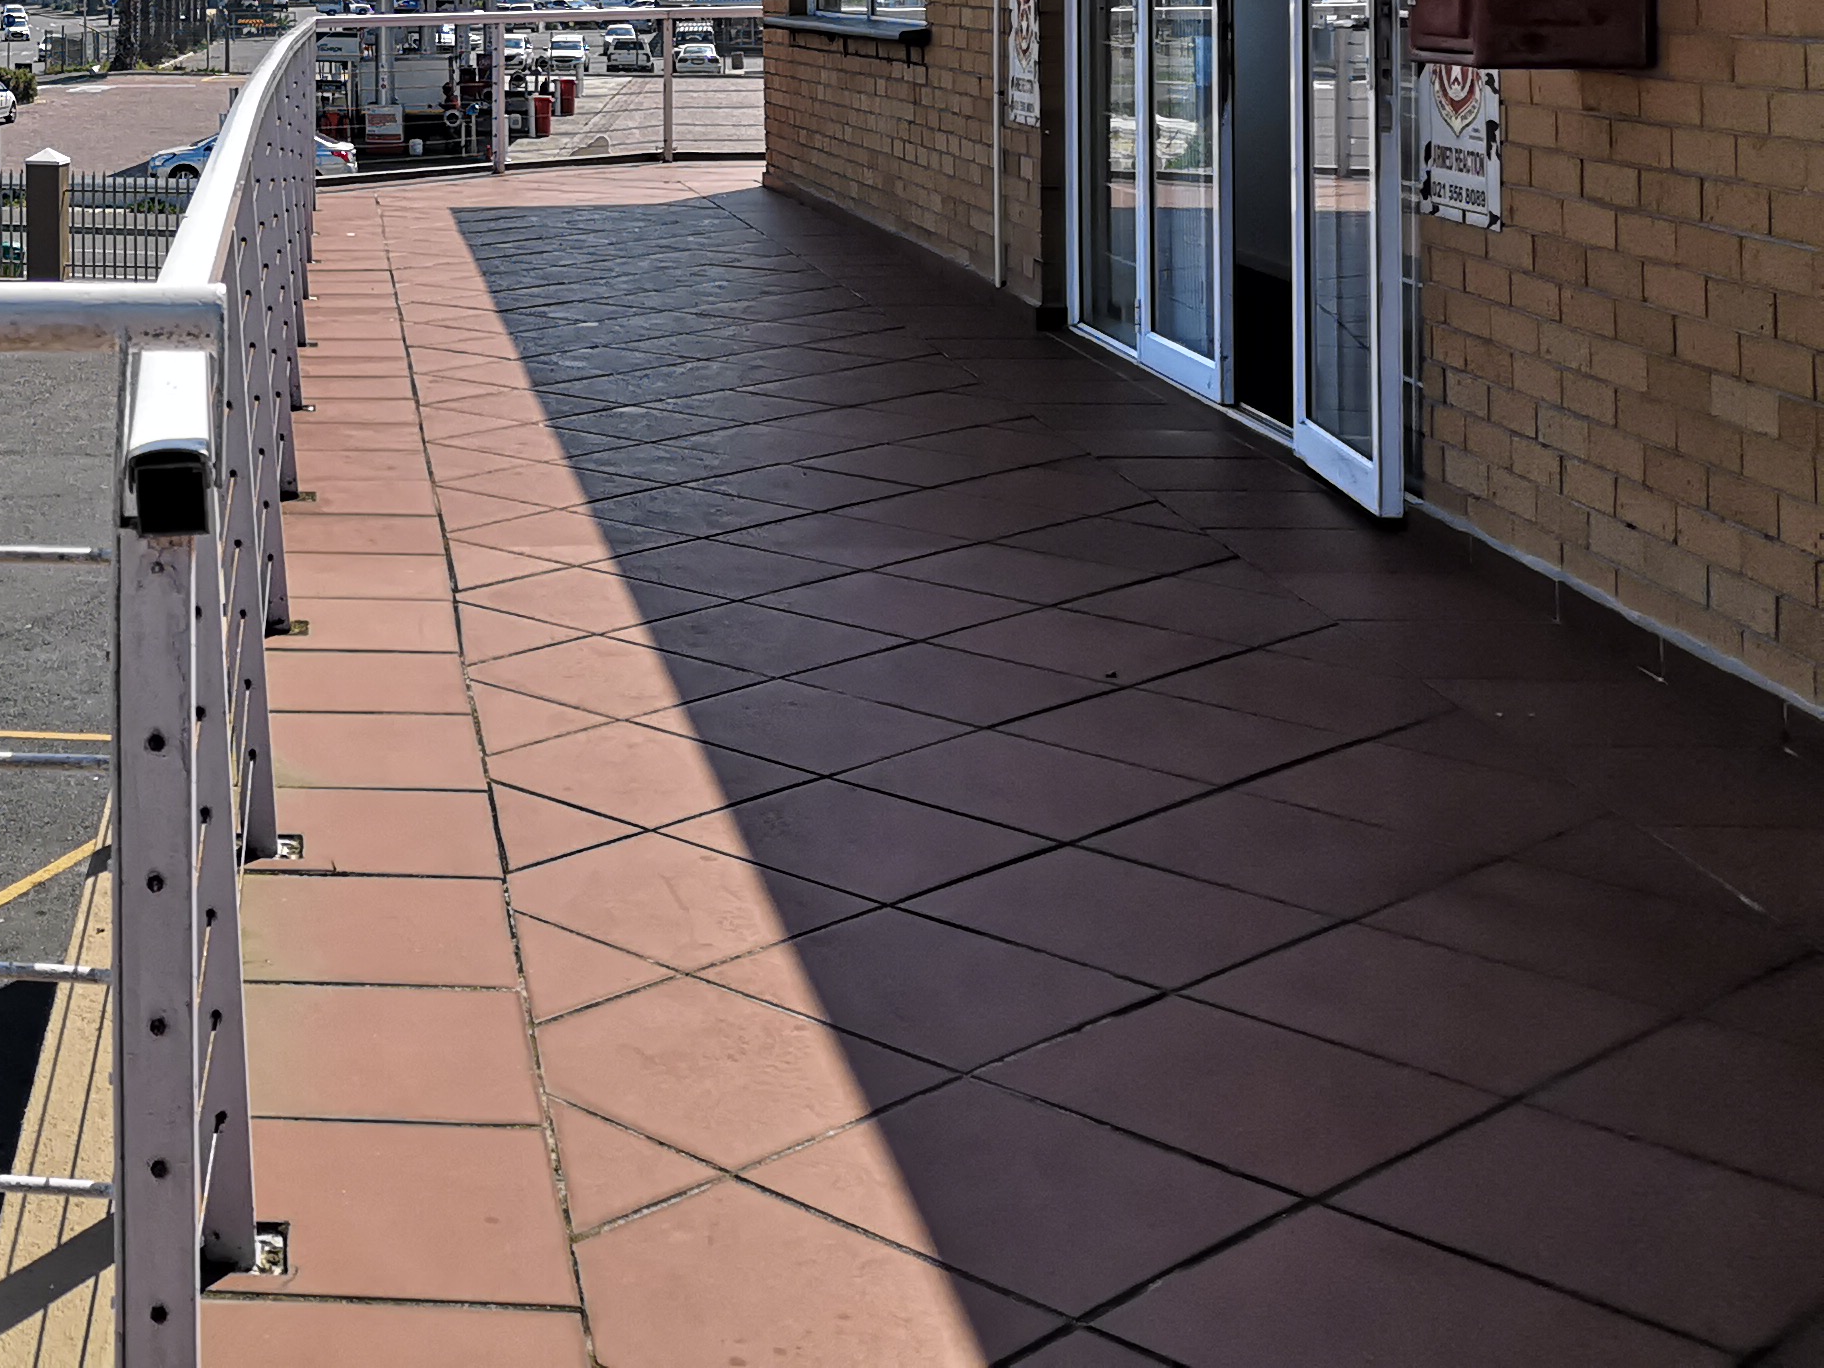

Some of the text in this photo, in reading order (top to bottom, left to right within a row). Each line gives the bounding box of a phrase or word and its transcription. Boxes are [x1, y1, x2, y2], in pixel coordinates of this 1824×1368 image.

[1433, 144, 1485, 177] ARMED REACTION
[1432, 181, 1446, 199] 021
